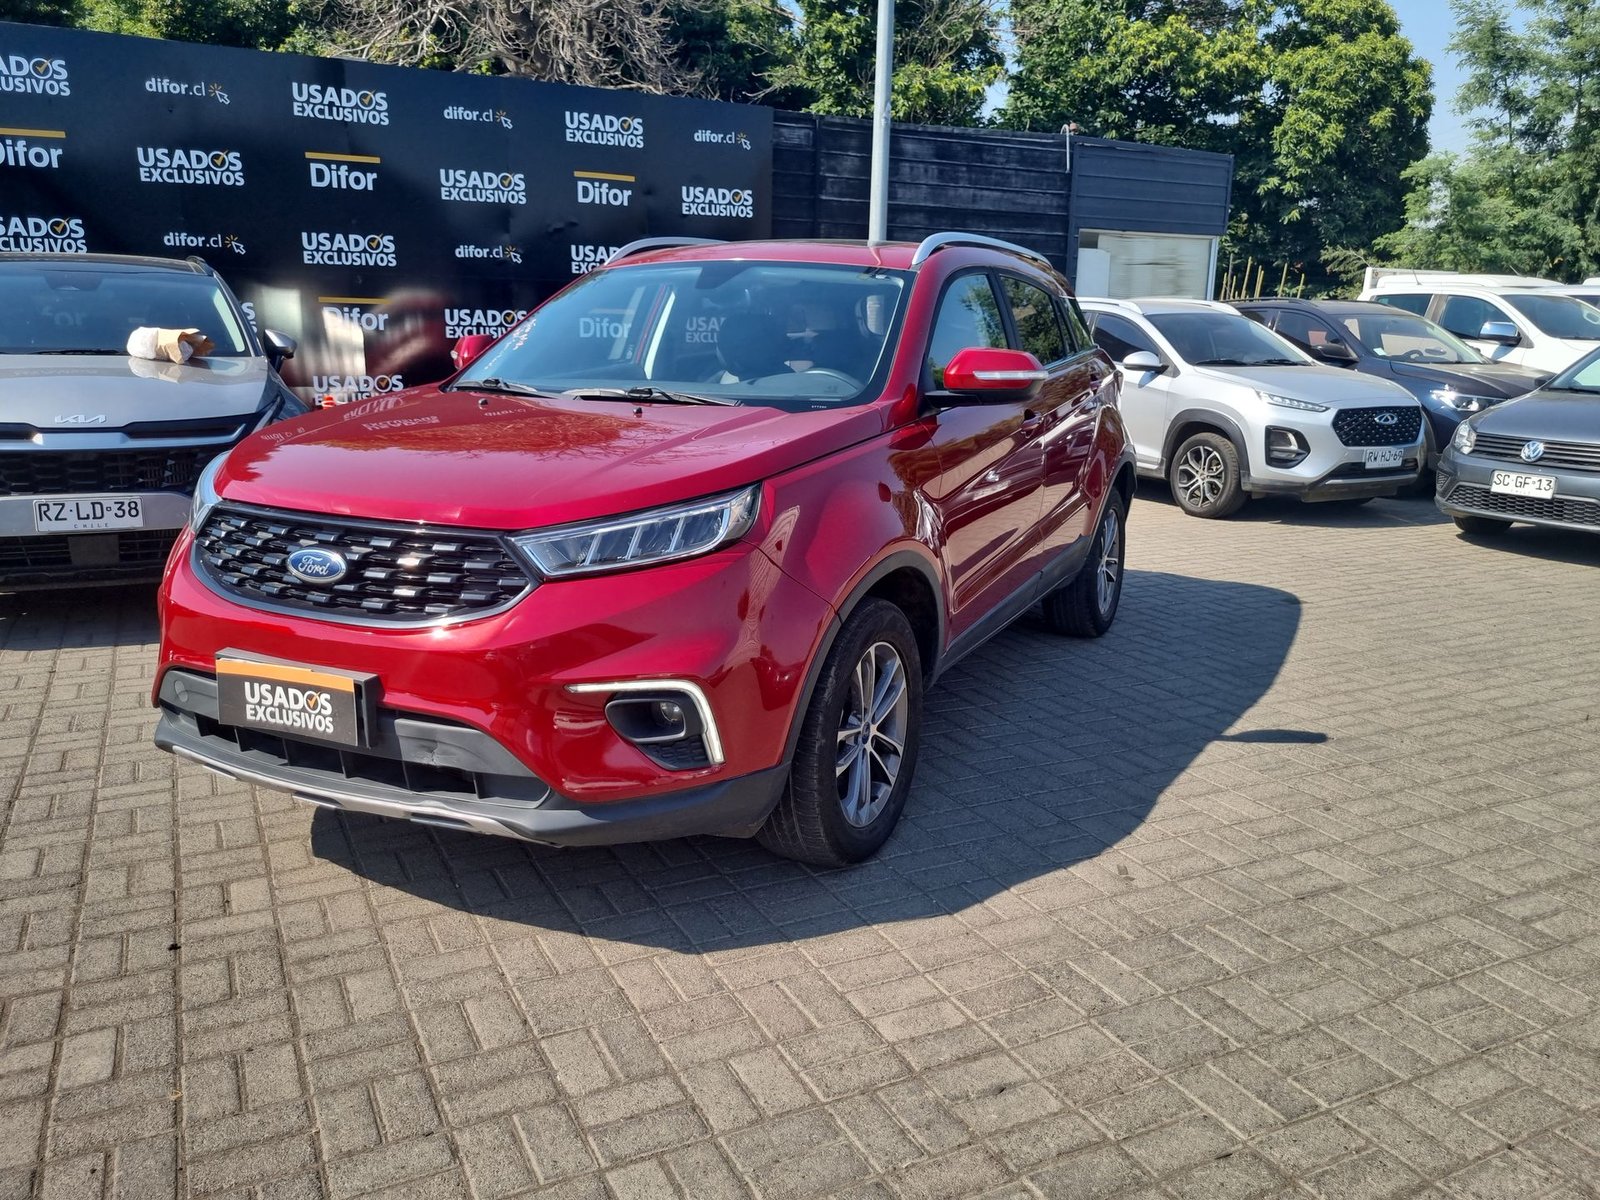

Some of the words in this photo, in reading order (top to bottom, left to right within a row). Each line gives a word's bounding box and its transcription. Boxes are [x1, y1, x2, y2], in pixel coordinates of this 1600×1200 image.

[0, 76, 71, 96] USIVOS
[145, 78, 206, 96] difor.cl
[292, 82, 388, 111] USADOS
[293, 102, 389, 126] EXCLUSIVOS
[443, 106, 493, 122] difor.cl
[565, 111, 643, 135] USADOS
[565, 128, 644, 148] EXCLUSIVOS
[694, 130, 735, 144] difor.cl
[0, 139, 63, 168] ifor
[137, 147, 242, 171] USADOS
[139, 167, 245, 186] EXCLUSIVOS
[310, 163, 377, 191] Difor
[439, 168, 525, 191] USADOS
[441, 187, 527, 204] EXCLUSIVOS
[577, 181, 632, 206] Difor
[682, 186, 753, 206] USADOS
[682, 203, 753, 218] EXCLUSIVOS
[163, 232, 222, 248] difor.cl
[301, 232, 395, 253] USADOS
[303, 250, 397, 267] EXCLUSIVOS
[455, 245, 503, 258] difor.cl
[444, 308, 528, 328] USADOS
[686, 316, 726, 331] USA
[312, 374, 404, 393] USADOS
[298, 556, 330, 576] Ford
[244, 681, 333, 716] USADOS
[246, 704, 334, 734] EXCLUSIVOS
